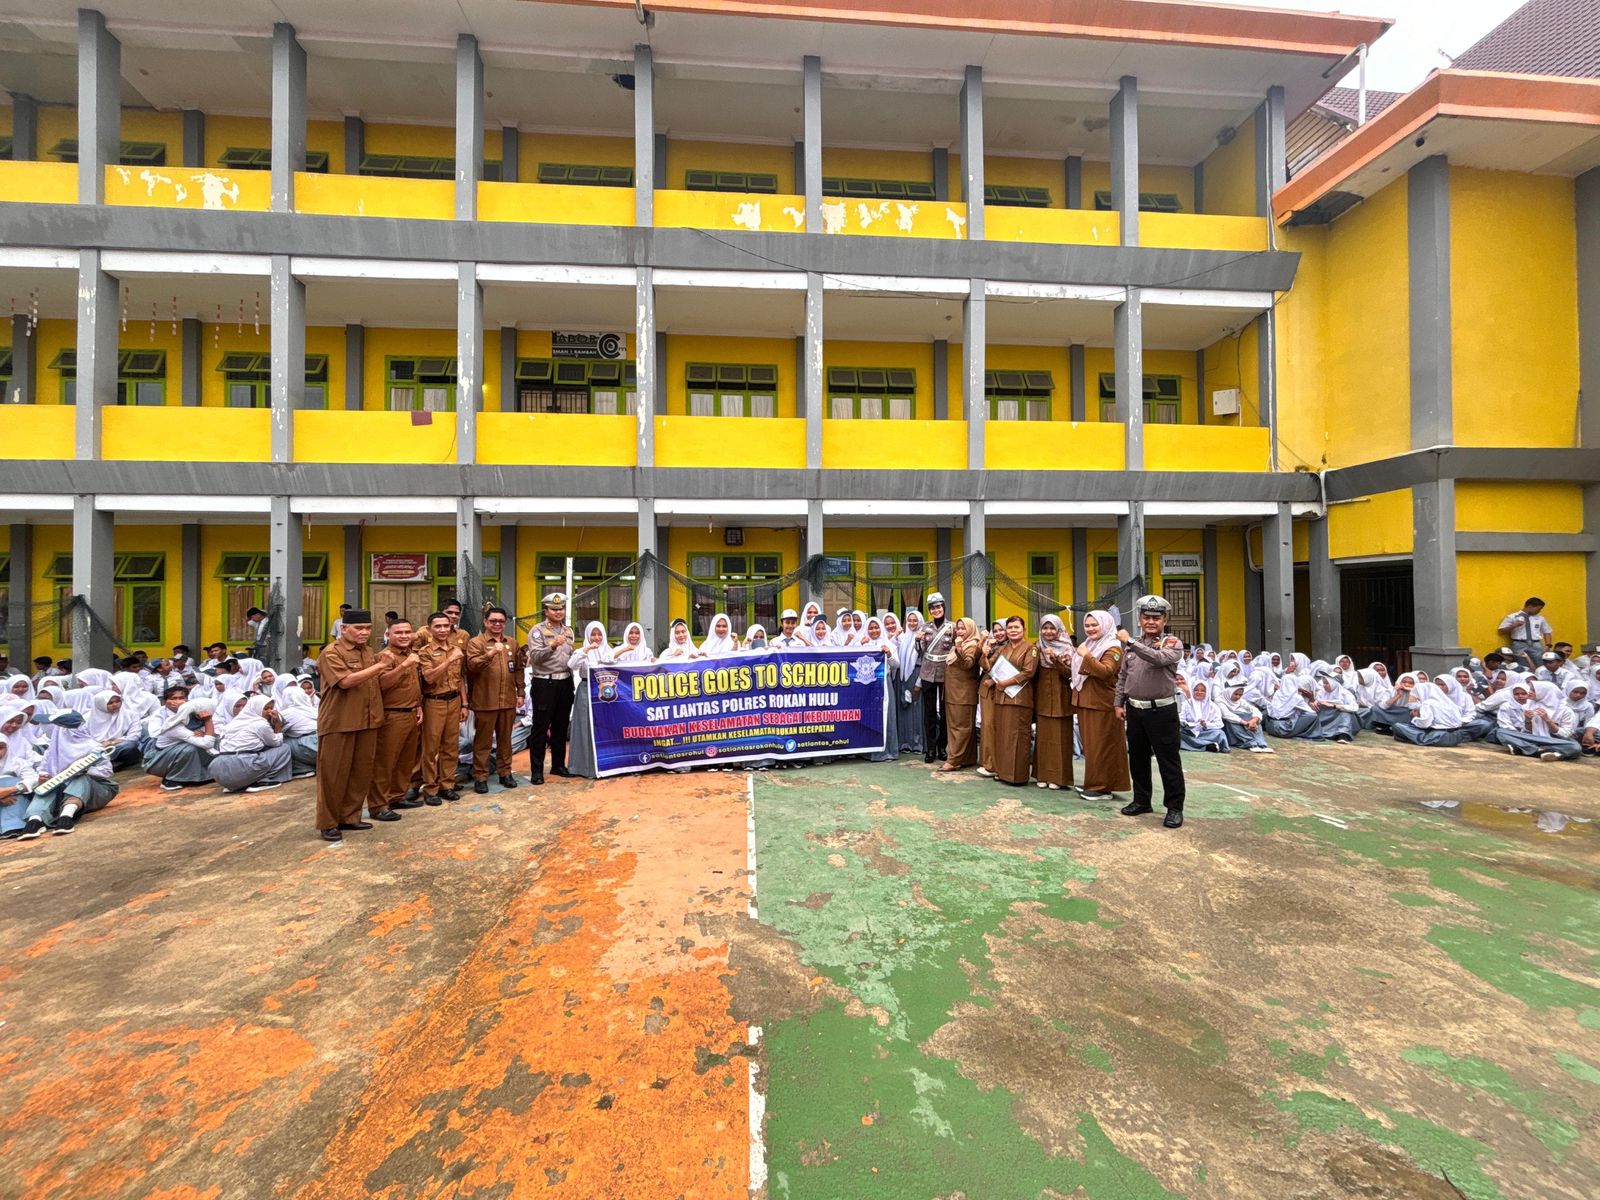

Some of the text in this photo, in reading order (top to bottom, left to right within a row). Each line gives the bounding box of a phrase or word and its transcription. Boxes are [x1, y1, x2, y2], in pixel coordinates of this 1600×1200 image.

[632, 661, 850, 702] POLICE GOES TO SCHOOL
[646, 692, 839, 722] SAT LANTAS POLRES ROKAN HULU
[623, 709, 861, 738] BUDAYAKAN KESELAMATAN SEBAGAI KEBUTUHAN
[692, 731, 727, 743] UTAMKAN
[728, 727, 776, 738] KESELAMATAN
[776, 726, 798, 736] BUKAN
[799, 724, 835, 734] KECEPATAN
